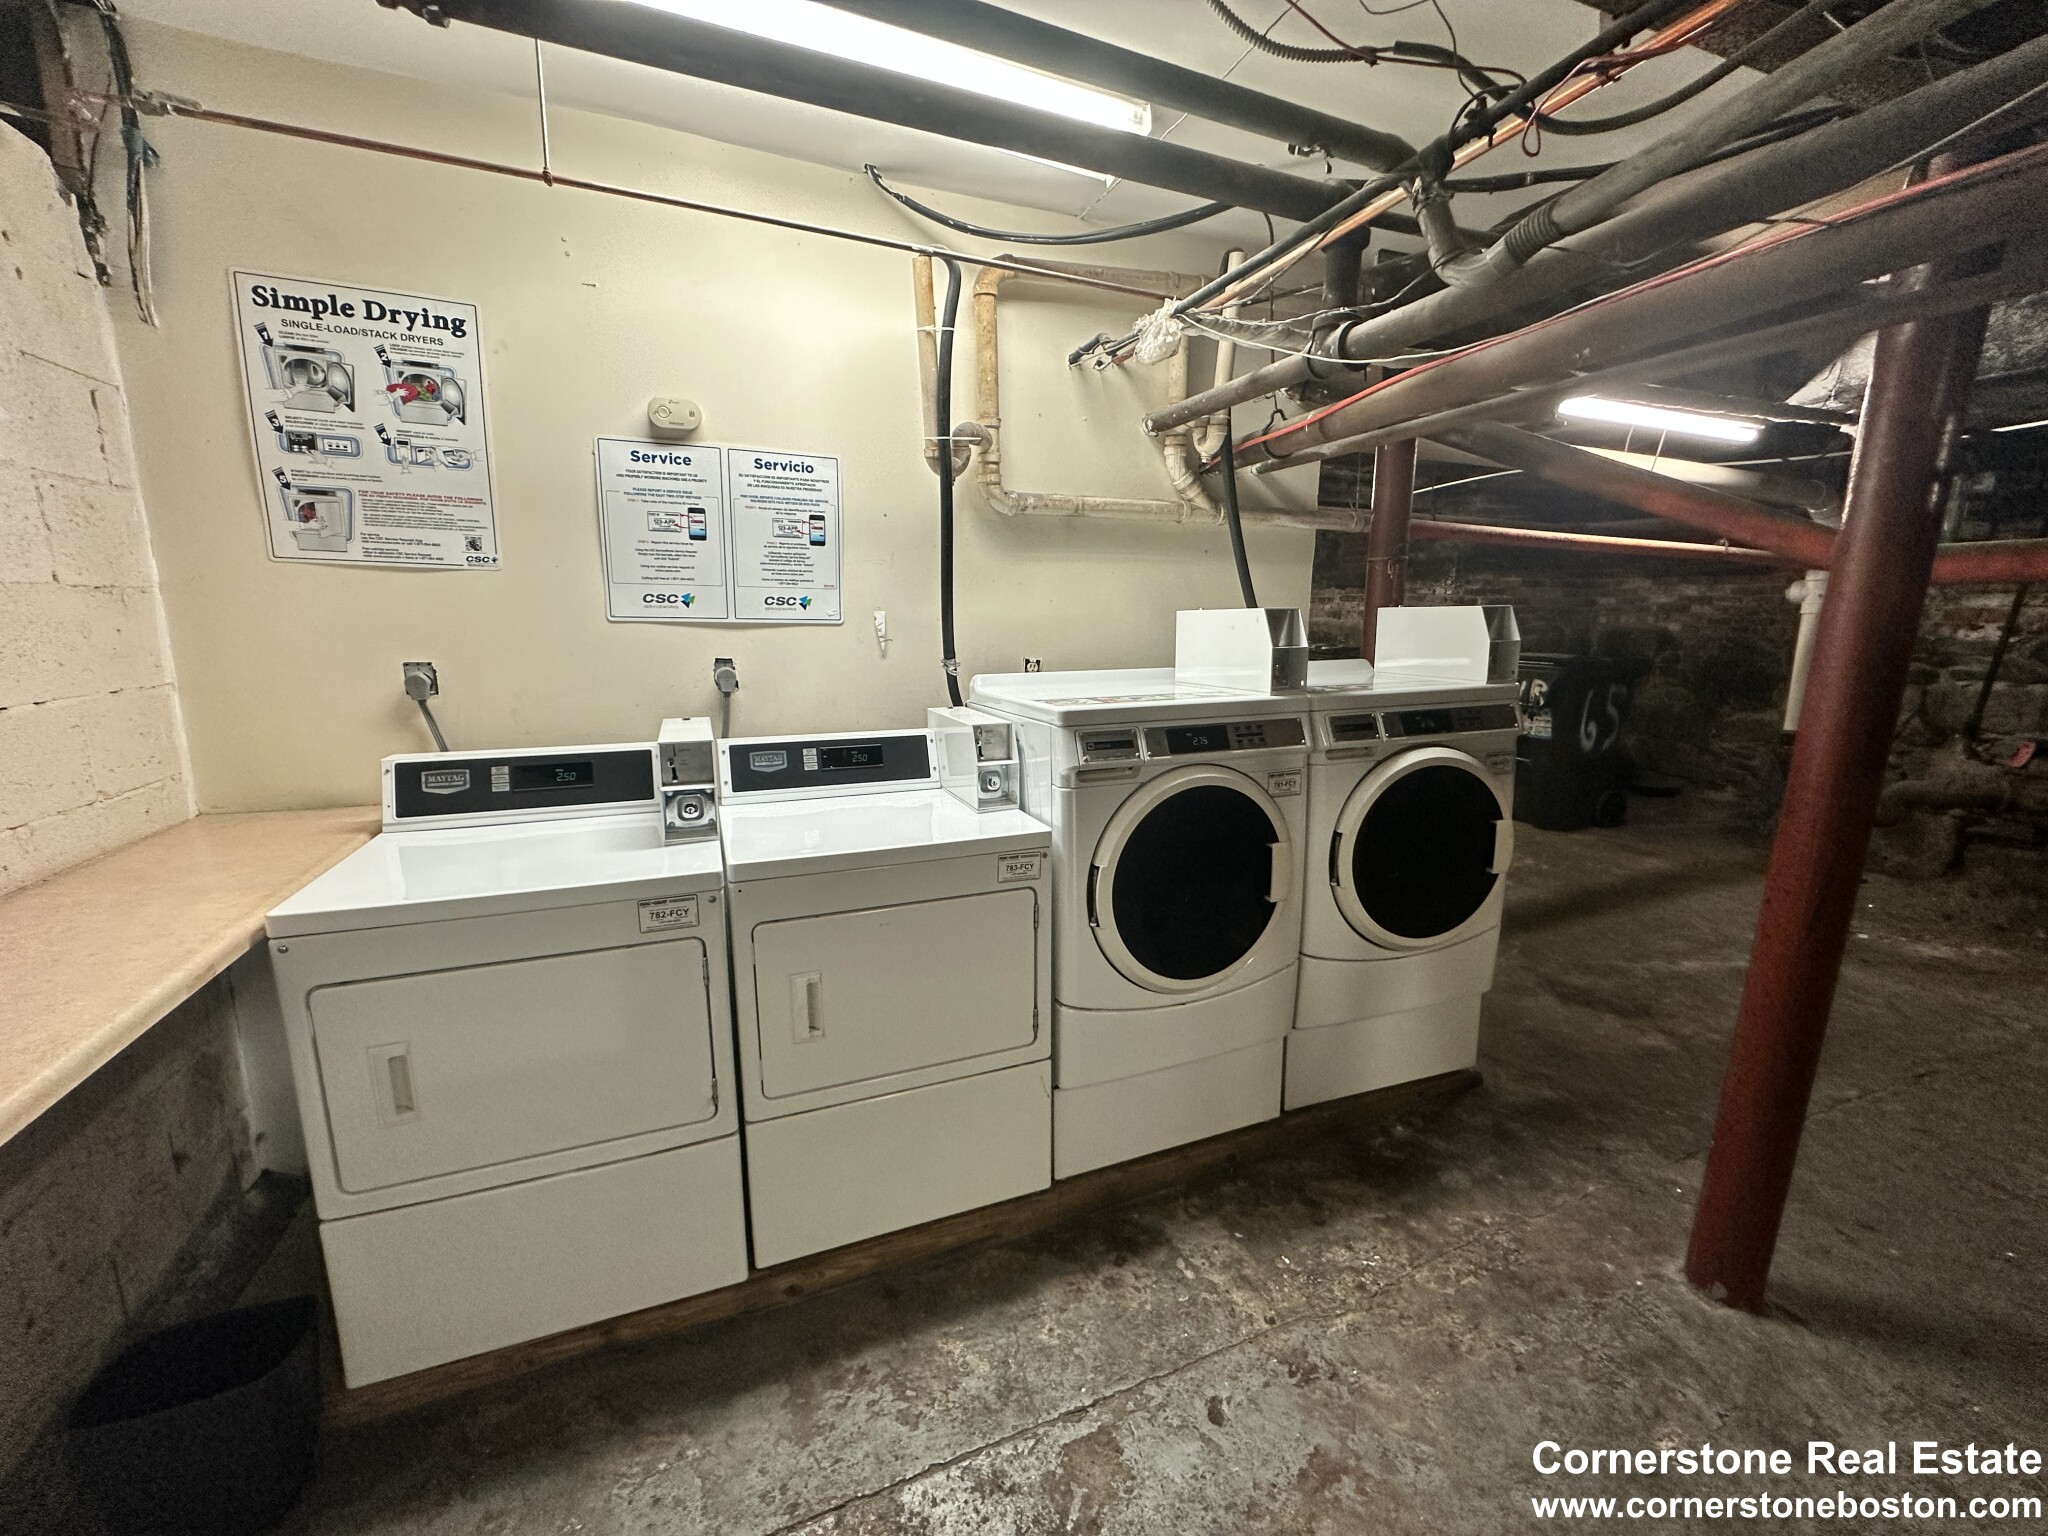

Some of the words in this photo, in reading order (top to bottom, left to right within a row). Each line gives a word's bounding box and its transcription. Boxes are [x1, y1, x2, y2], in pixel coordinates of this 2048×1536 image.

[251, 285, 355, 321] Simple
[362, 299, 467, 338] Drying
[281, 319, 398, 341] SINGLE-LOAD/STACK
[400, 333, 444, 346] DRYERS
[272, 418, 279, 427] 3
[630, 450, 692, 466] Service
[754, 458, 814, 473] Servicio
[280, 475, 286, 483] 5
[643, 593, 679, 604] CSC
[764, 596, 797, 606] CSC
[1580, 684, 1627, 753] 65
[755, 754, 783, 762] MAYTAG
[427, 774, 464, 783] MAYTAG
[1274, 780, 1297, 788] 781-FCY
[1006, 863, 1035, 871] 783-FCY
[649, 908, 689, 919] 782-FCY
